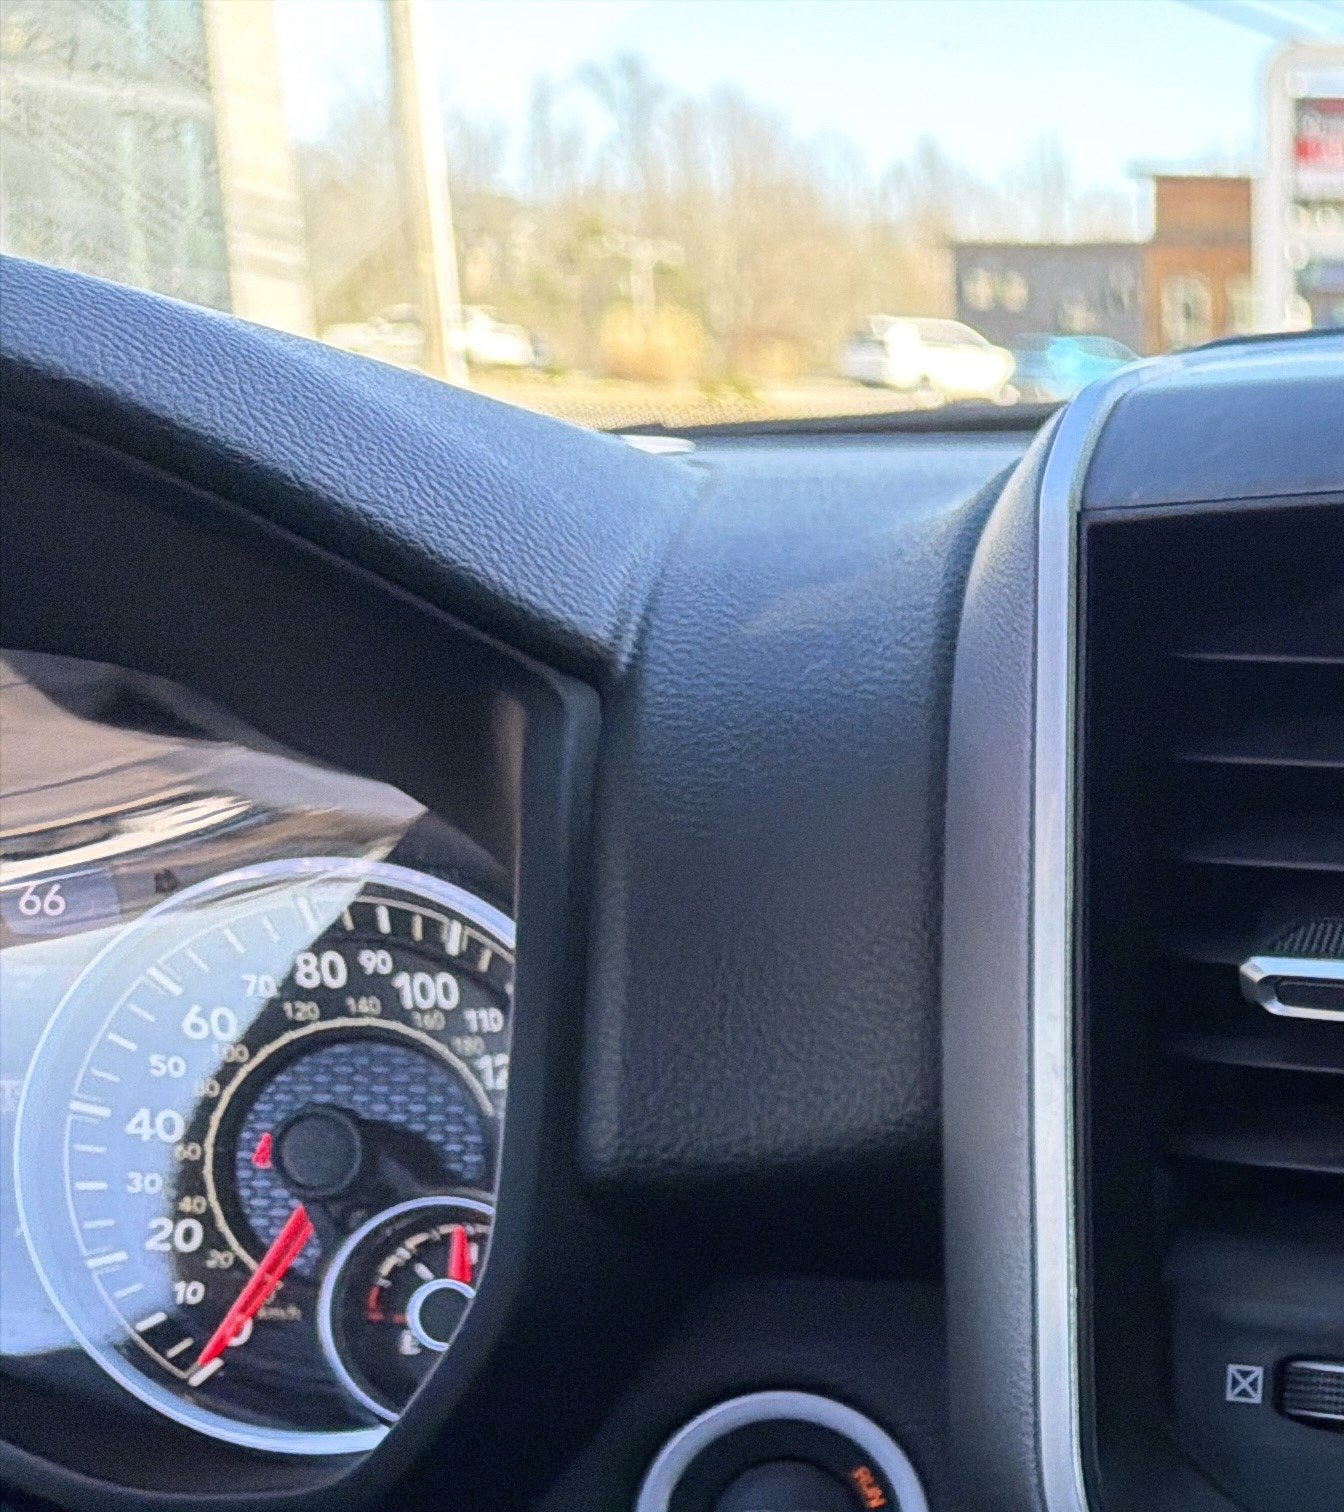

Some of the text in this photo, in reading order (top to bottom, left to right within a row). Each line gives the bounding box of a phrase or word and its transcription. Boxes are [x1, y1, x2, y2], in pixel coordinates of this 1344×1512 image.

[18, 882, 67, 917] 66
[294, 949, 348, 990] 80
[358, 949, 394, 976] 90
[241, 973, 278, 999] 70
[391, 971, 460, 1011] 100
[181, 1004, 239, 1042] 60
[463, 1007, 505, 1034] 110
[148, 1052, 187, 1079] 50
[474, 1052, 510, 1091] 12
[125, 1107, 186, 1144] 40
[126, 1171, 164, 1195] 30
[145, 1216, 204, 1254] 20
[173, 1280, 206, 1306] 10
